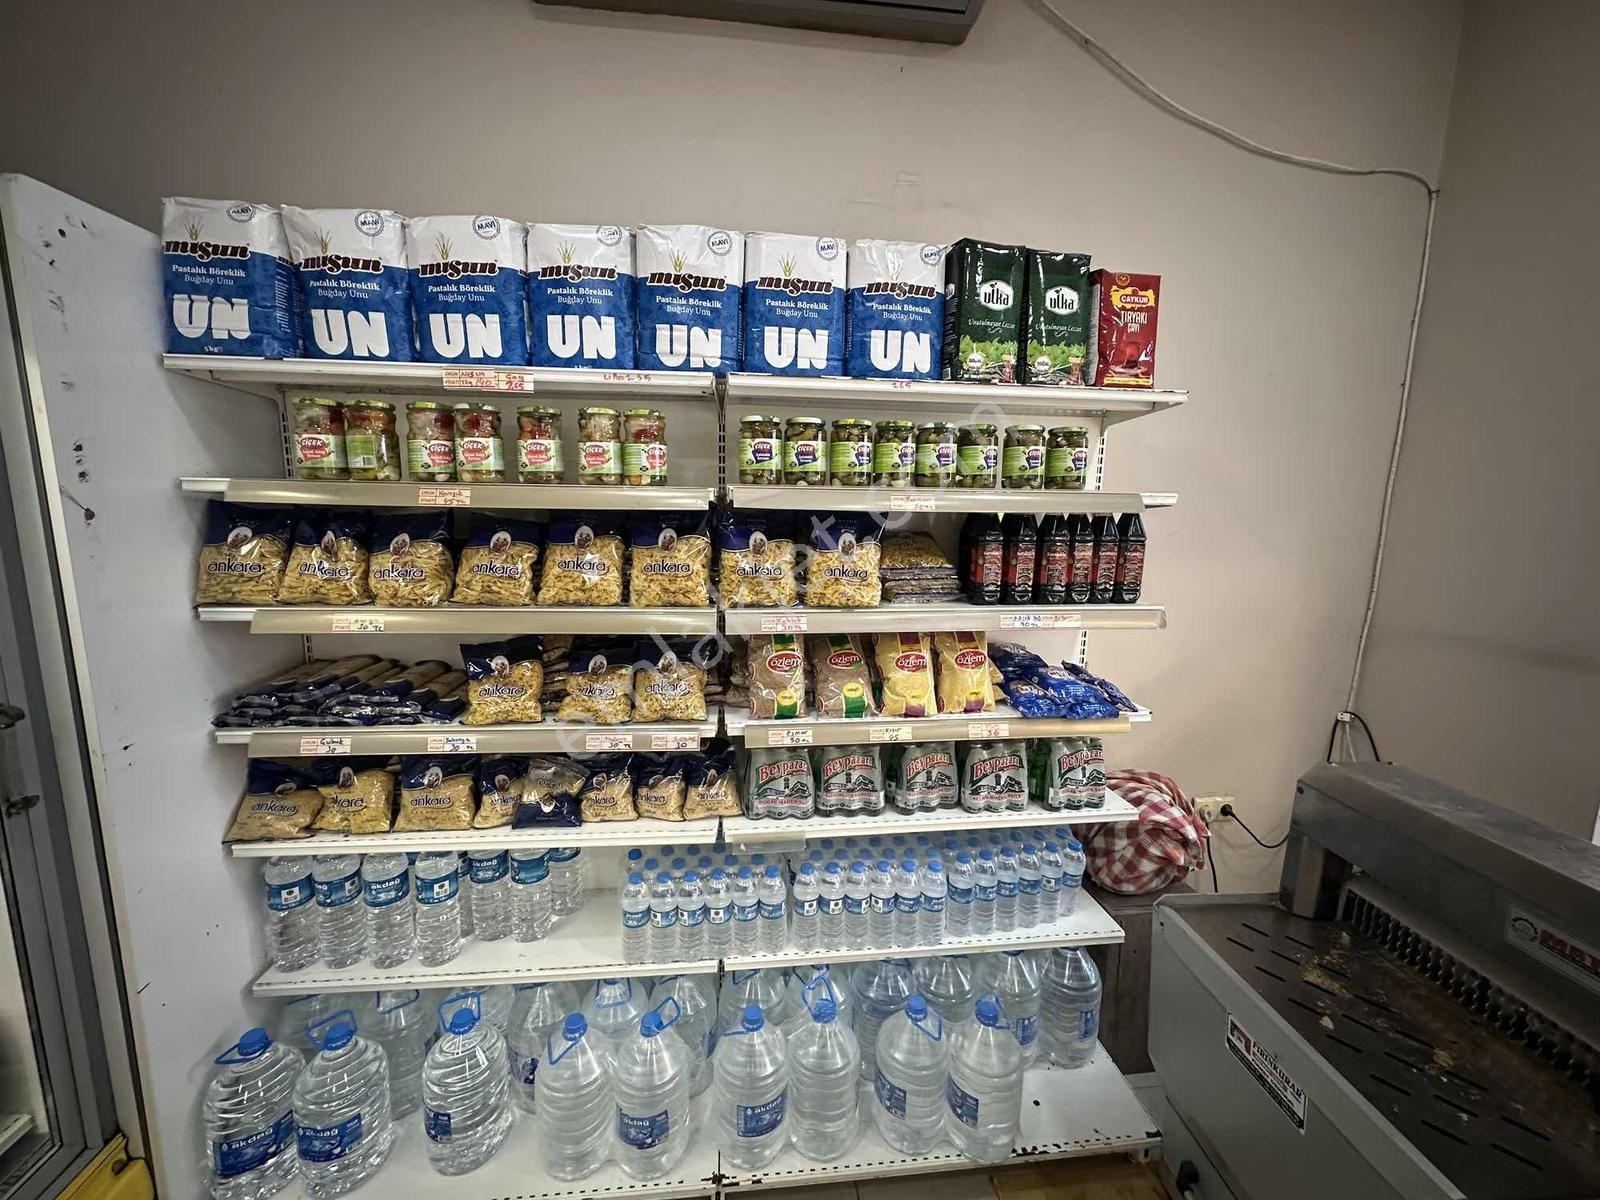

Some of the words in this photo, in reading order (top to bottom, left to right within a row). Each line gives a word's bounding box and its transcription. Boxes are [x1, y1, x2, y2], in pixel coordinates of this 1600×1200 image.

[172, 265, 207, 274] Pastalık
[209, 268, 246, 277] Böreklik
[217, 277, 234, 285] Unu
[340, 280, 380, 291] Böreklik
[350, 290, 368, 298] Unu
[428, 284, 458, 292] Pastalık
[547, 287, 577, 295] Pastalık
[579, 288, 613, 296] Böreklik
[586, 296, 602, 304] Unu
[656, 296, 687, 305] Pastalık
[689, 298, 722, 308] Böreklik
[766, 299, 796, 308] Pastalık
[797, 301, 829, 310] Böreklik
[696, 306, 711, 316] Unu
[804, 310, 818, 318] Unu
[873, 303, 902, 311] Pastalık
[904, 304, 932, 314] Böreklik
[173, 294, 251, 339] UN
[910, 313, 922, 321] Unu
[311, 309, 390, 357] UN
[429, 313, 502, 358] UN
[547, 315, 616, 359] UN
[656, 324, 722, 368] UN
[764, 326, 828, 369] UN
[870, 330, 931, 373] UN
[208, 558, 262, 574] ankara
[300, 561, 349, 578] ankara
[472, 560, 520, 576] ankara
[558, 556, 606, 572] ankara
[644, 558, 691, 574] ankara
[737, 562, 782, 577] ankara
[374, 564, 424, 579] ankara
[824, 564, 869, 580] ankara
[771, 656, 800, 667] özlem
[832, 654, 860, 664] özlem
[898, 655, 926, 666] özlem
[957, 652, 984, 664] özlem
[479, 684, 524, 697] ankara
[252, 800, 296, 814] ankara
[410, 794, 452, 807] ankara
[370, 878, 400, 891] akdağ
[230, 1128, 274, 1150] akdağ
